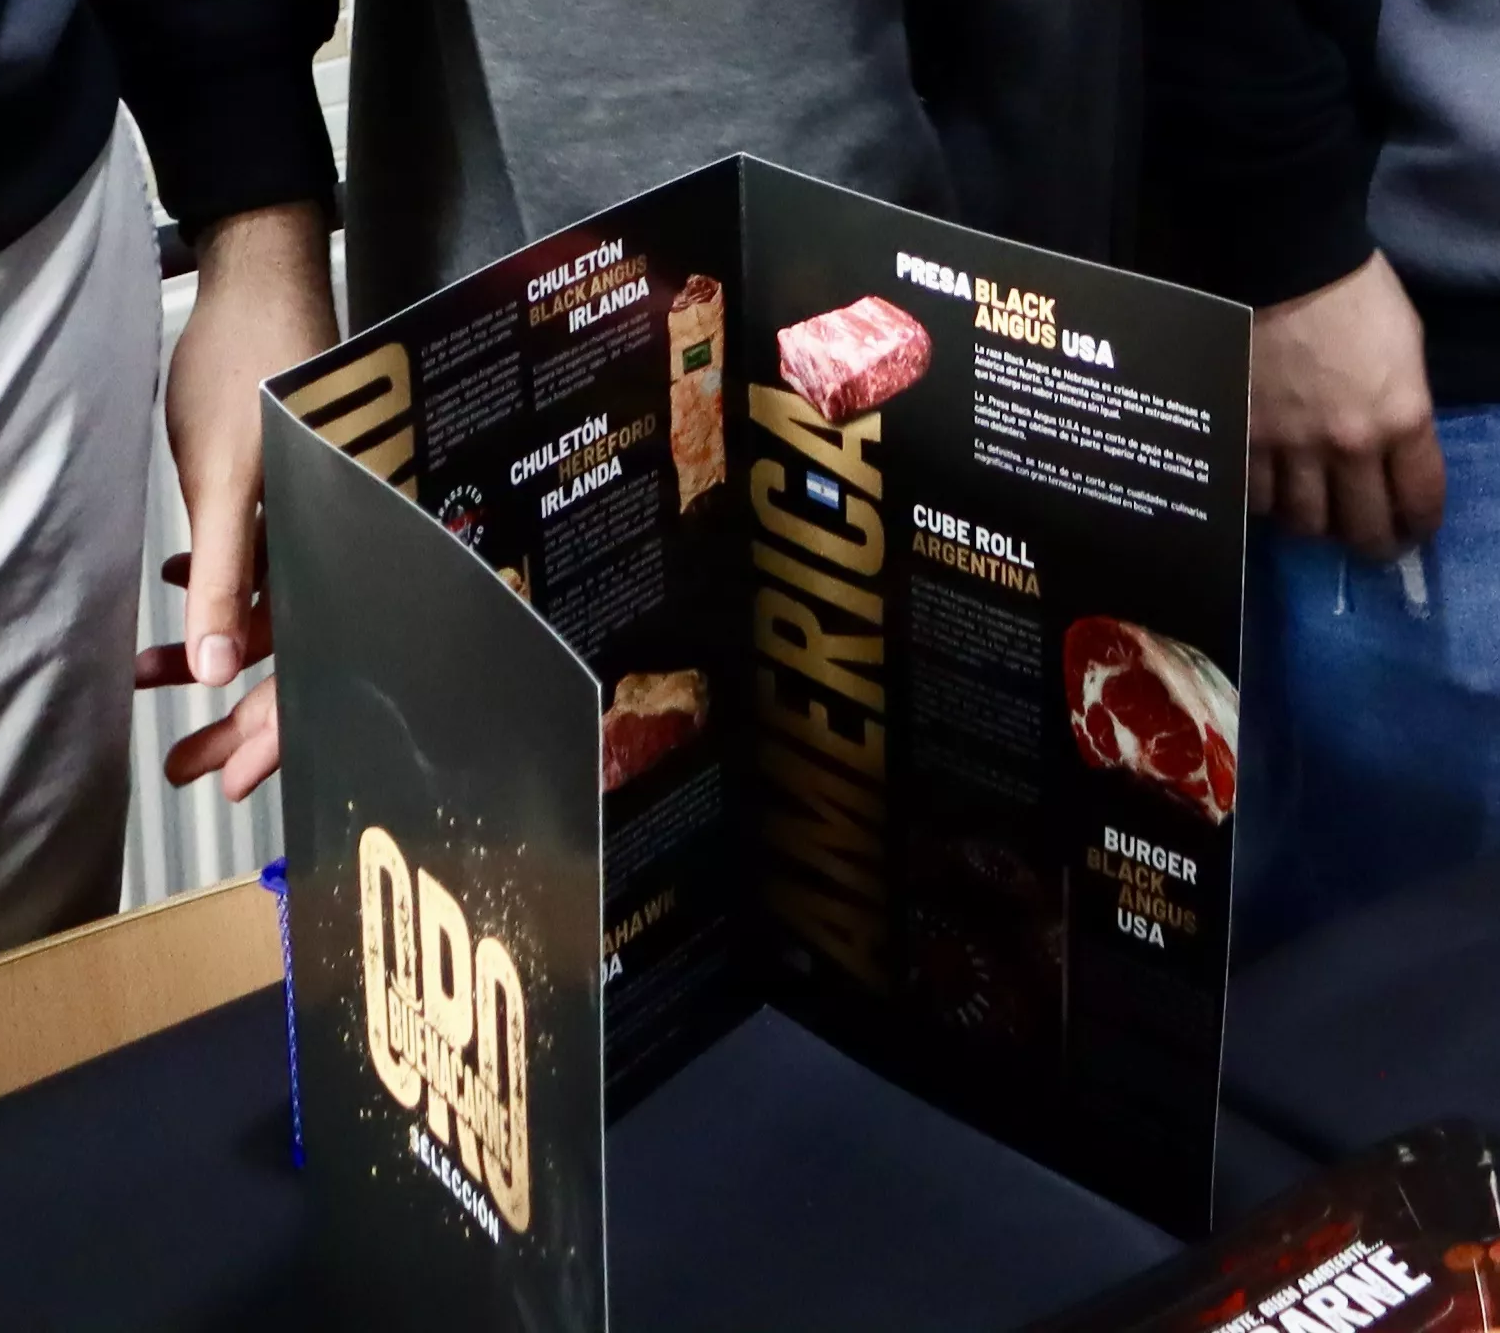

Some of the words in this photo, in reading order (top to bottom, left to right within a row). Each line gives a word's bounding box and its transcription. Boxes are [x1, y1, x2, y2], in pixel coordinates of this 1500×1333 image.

[527, 237, 623, 303] CHULETÓN
[529, 284, 588, 328] BLACK
[589, 253, 648, 298] ANGUS
[896, 251, 972, 301] PRESA
[974, 277, 1056, 324] BLACK
[568, 275, 650, 334] IRLANDA
[974, 304, 1057, 350] ANGUS
[1061, 329, 1115, 369] USA
[509, 412, 608, 486] CHULETÓN
[558, 412, 657, 483] HEREFORD
[540, 455, 623, 519] IRLANDA
[912, 530, 1041, 599] ARGENTINA
[913, 503, 971, 546] CUBE
[975, 525, 1035, 569] ROLL
[1086, 846, 1165, 897] BLACK
[1104, 825, 1197, 885] BURGER
[1117, 907, 1165, 949] USA
[1118, 882, 1197, 936] ANGUS
[410, 1122, 500, 1245] SELECCIÓN
